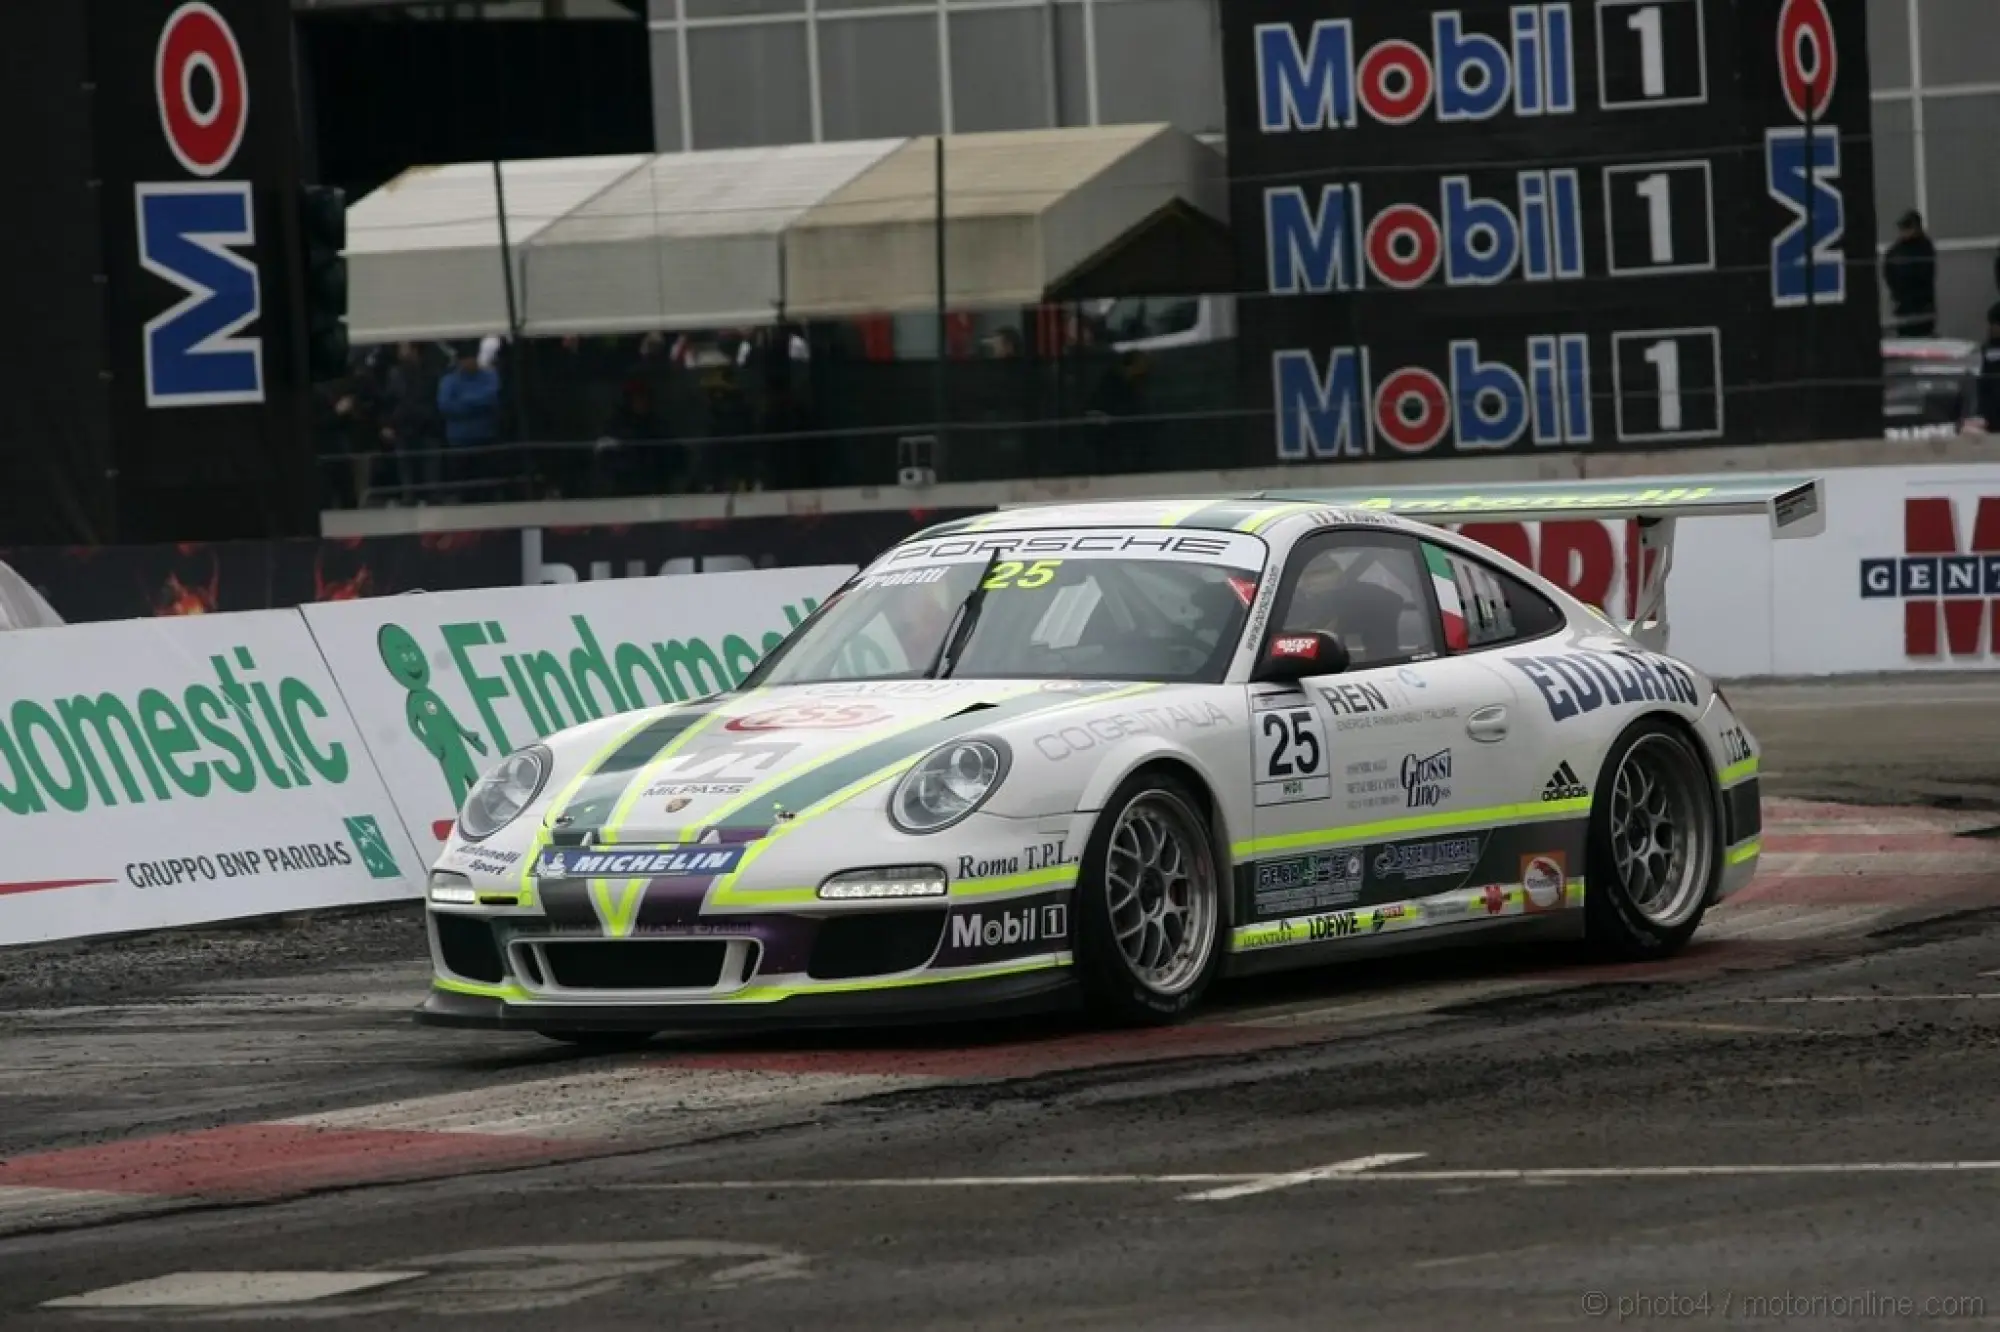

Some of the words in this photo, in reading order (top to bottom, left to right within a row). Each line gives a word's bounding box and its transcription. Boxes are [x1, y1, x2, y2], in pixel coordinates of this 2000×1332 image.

[1254, 2, 1576, 132] Mobil
[1626, 6, 1667, 97] 1
[1264, 168, 1584, 295] Mobil
[1635, 173, 1673, 264] 1
[1272, 333, 1593, 460] Mobil
[1643, 339, 1682, 431] 1
[886, 535, 1231, 566] PORSCHE
[984, 560, 1063, 589] 25
[1263, 711, 1320, 776] 25
[126, 854, 217, 889] GRUPPO
[217, 849, 261, 878] BNP
[259, 840, 353, 873] PARIBAS
[572, 851, 734, 873] MICHELIN
[957, 854, 1019, 880] Roma
[952, 907, 1036, 948] Mobil
